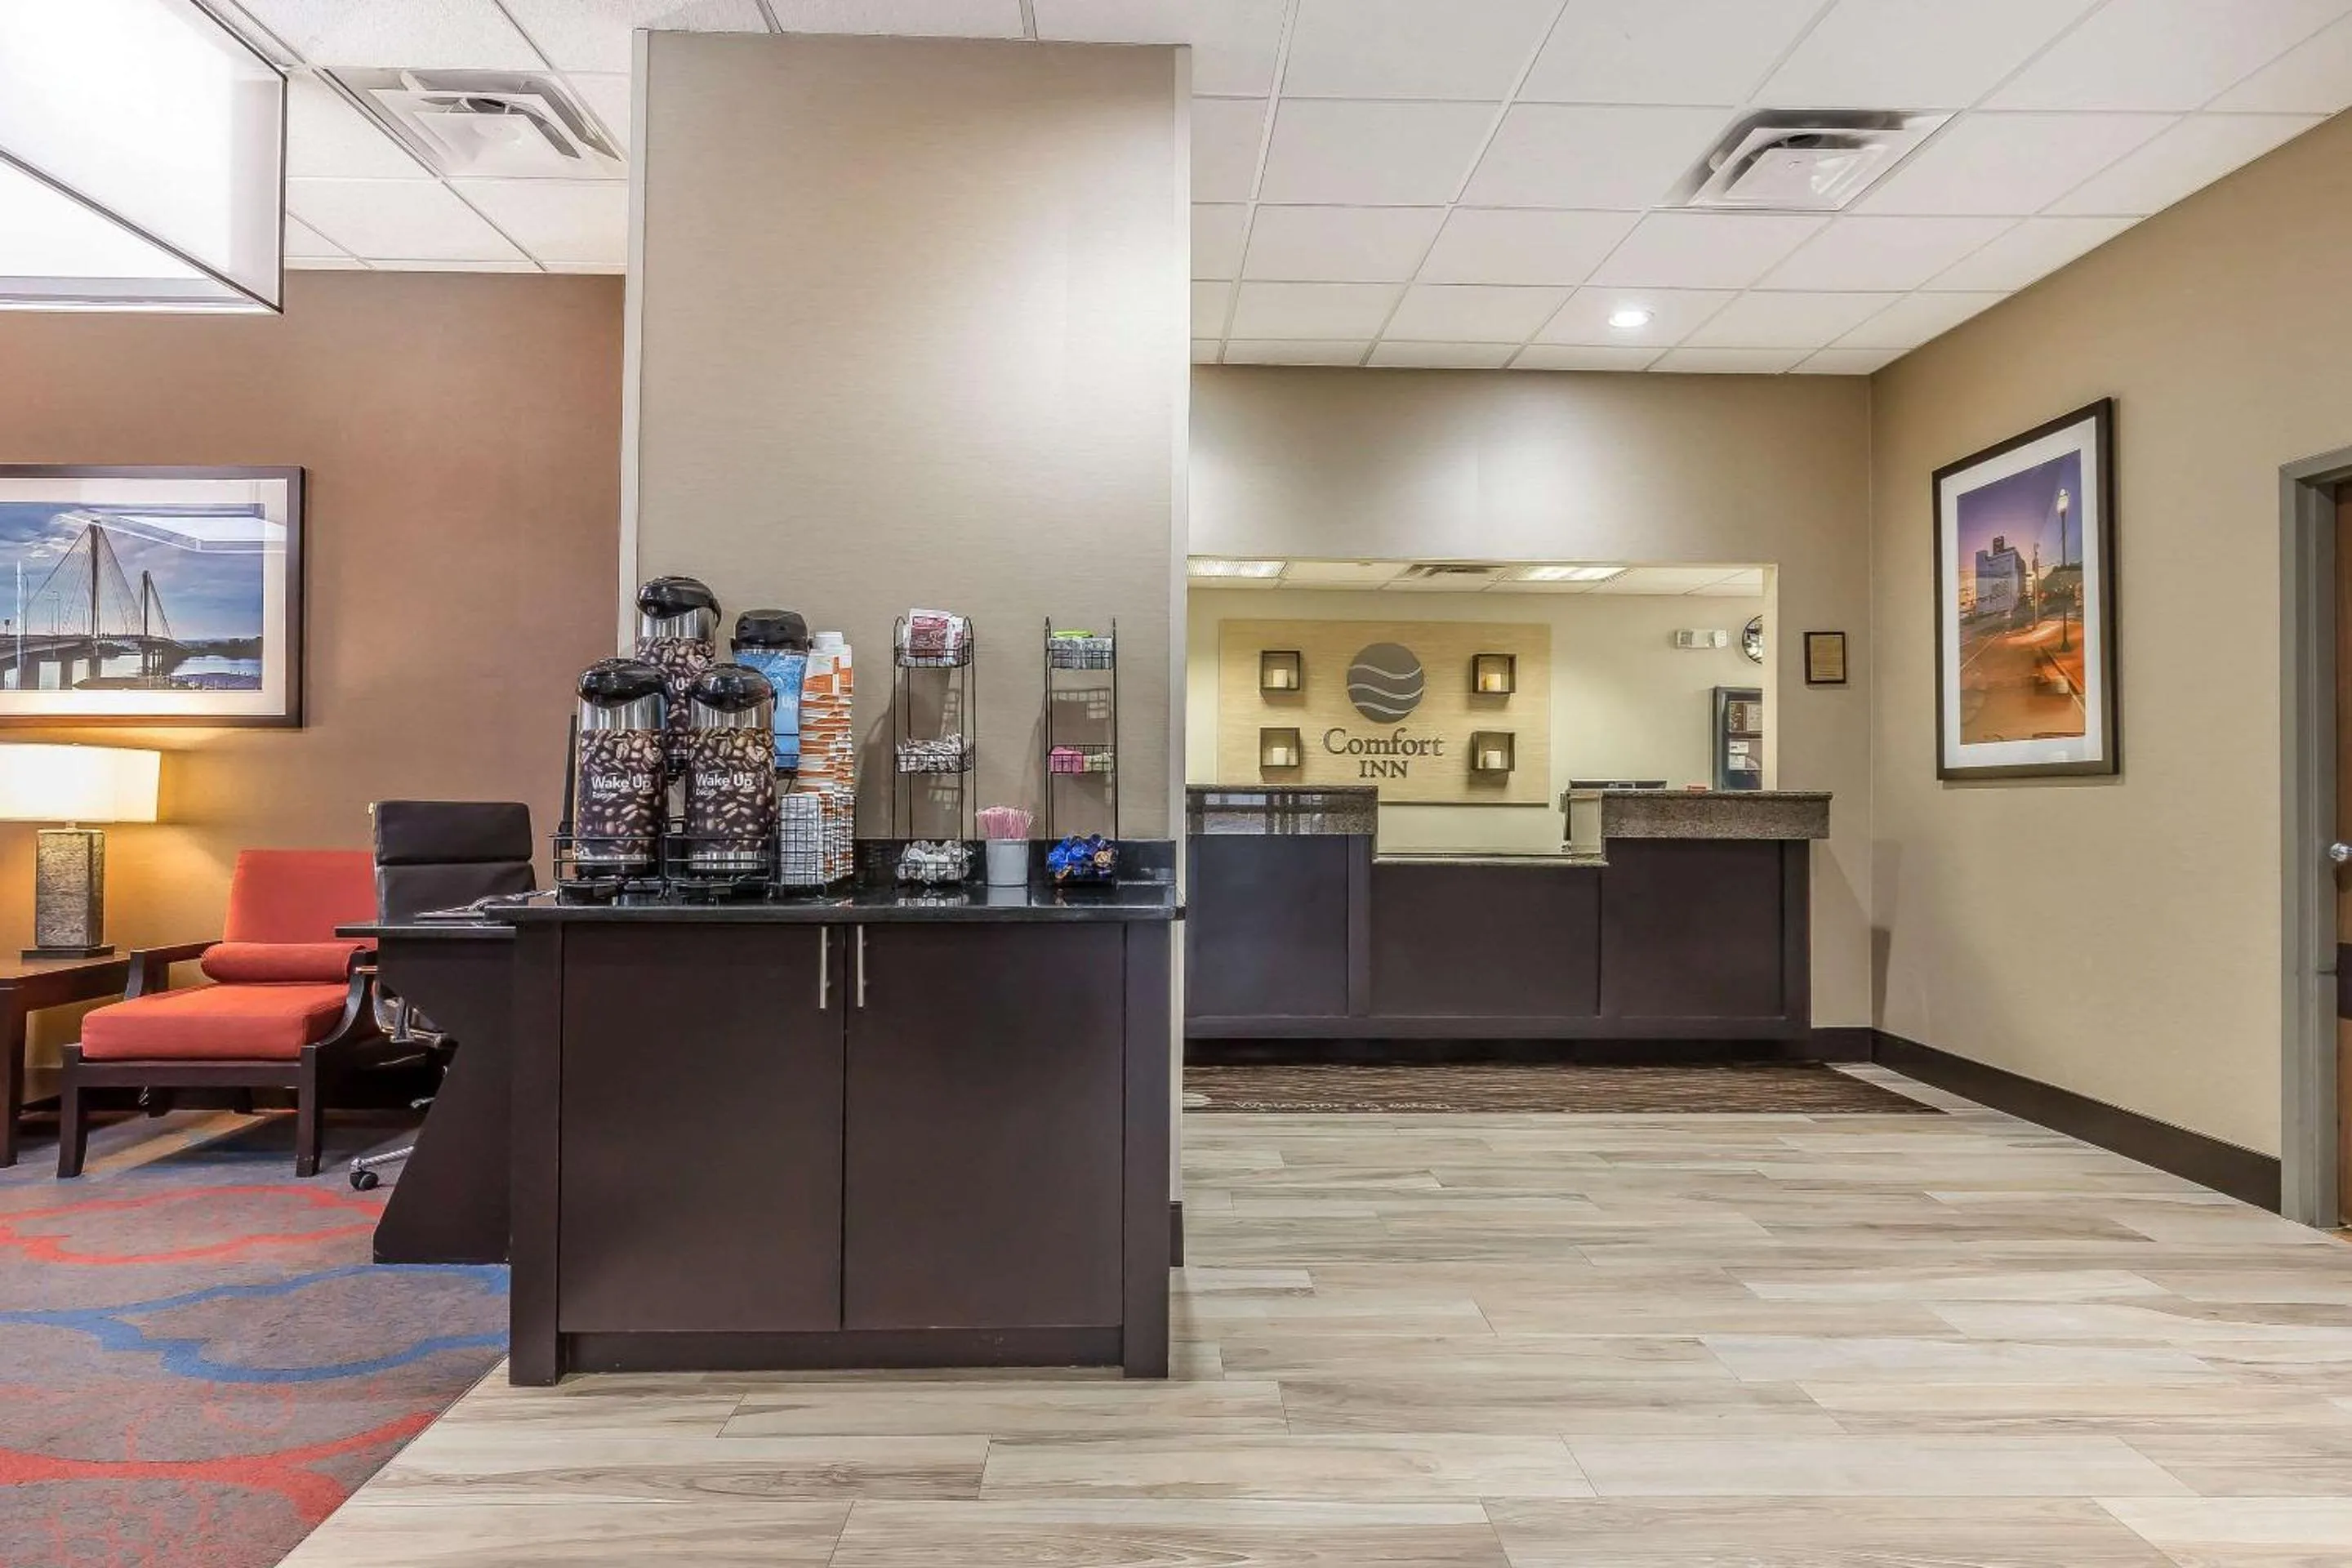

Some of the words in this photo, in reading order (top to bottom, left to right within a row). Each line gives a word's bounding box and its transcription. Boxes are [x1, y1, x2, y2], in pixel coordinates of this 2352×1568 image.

[1322, 727, 1445, 756] Comfort
[1359, 760, 1408, 778] INN
[590, 775, 630, 790] Wake
[632, 775, 652, 791] Up
[695, 773, 730, 786] Wake
[733, 773, 753, 790] Up
